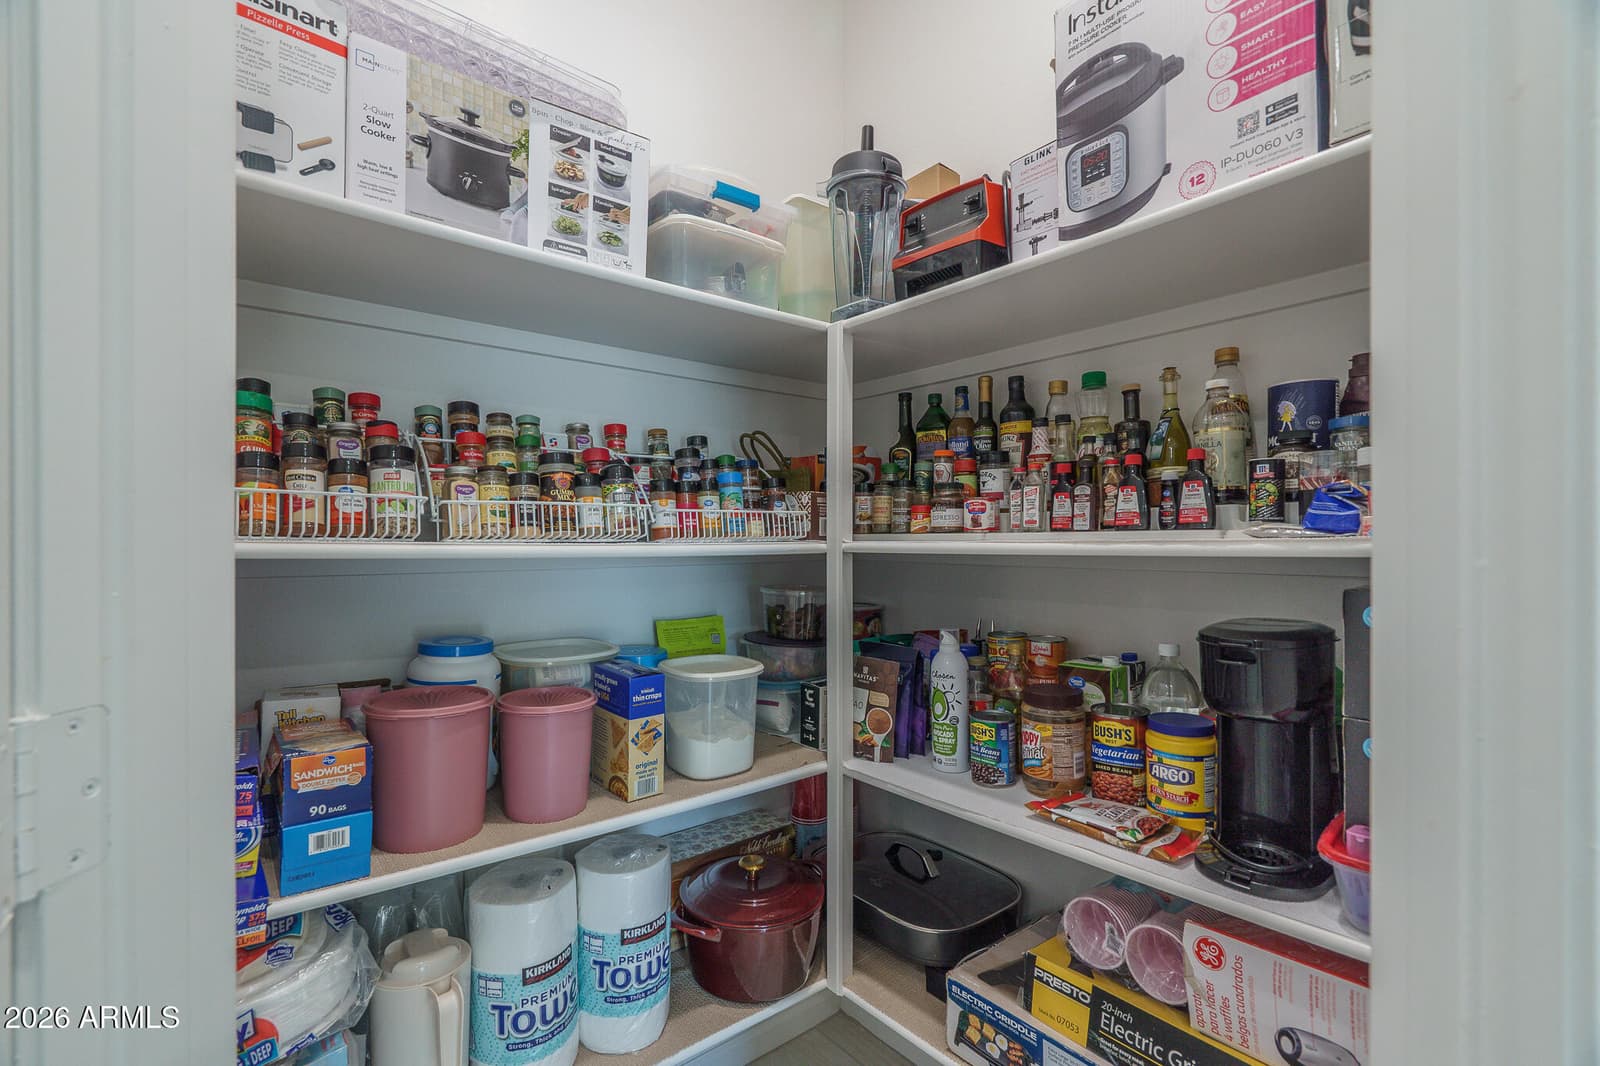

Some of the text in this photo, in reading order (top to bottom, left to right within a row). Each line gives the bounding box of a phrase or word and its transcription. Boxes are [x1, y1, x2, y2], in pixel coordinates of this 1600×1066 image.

[246, 0, 337, 37] sinart
[1068, 0, 1122, 35] Insta
[1240, 0, 1267, 20] EASY
[247, 9, 310, 41] Pizzelle Press
[1068, 31, 1100, 54] PRESSURE
[1101, 14, 1128, 34] COOKER
[1241, 29, 1276, 51] SMART
[1241, 57, 1288, 84] HEALTHY
[362, 103, 395, 119] 2-Quart
[366, 115, 391, 129] Slow
[360, 125, 397, 142] Cooker
[1024, 147, 1053, 166] GLINK
[1220, 137, 1282, 169] IP-DUO60
[1285, 127, 1304, 143] V3
[1188, 173, 1206, 188] 12
[1196, 440, 1222, 449] ANILLA
[932, 670, 956, 680] Chosen
[632, 691, 662, 703] thin crisps
[276, 708, 297, 720] Tall
[278, 714, 326, 728] Kitchen
[940, 737, 956, 745] SPRAY
[1094, 724, 1132, 742] BUSH'S
[980, 747, 1001, 757] Beans
[1023, 746, 1046, 760] atural
[1092, 744, 1140, 761] Vegetarian
[294, 763, 353, 781] SANDWICH
[635, 759, 659, 770] original
[1095, 765, 1133, 775] BAKED BEANS
[1151, 764, 1190, 784] ARGO
[239, 791, 253, 800] 75
[1151, 785, 1190, 805] CORN STARCH
[309, 803, 347, 817] 90 BAGS
[624, 915, 666, 939] KIRKLAND
[525, 947, 572, 979] KIRKLAND
[1033, 966, 1091, 1004] PRESTO
[630, 992, 646, 1001] Thick
[1231, 954, 1250, 1050] belgas cuadrados
[951, 984, 1038, 1042] ELECTRIC GRIDDLE
[1101, 1000, 1133, 1025] 20-inch
[1193, 991, 1206, 1029] aparat
[1205, 980, 1221, 1036] para hacer
[1220, 995, 1233, 1034] waffles
[1056, 1015, 1080, 1035] 07053
[508, 1041, 533, 1051] Strong,
[535, 1034, 552, 1045] Thick
[1100, 1011, 1165, 1061] Electric
[250, 1042, 272, 1065] DEEP
